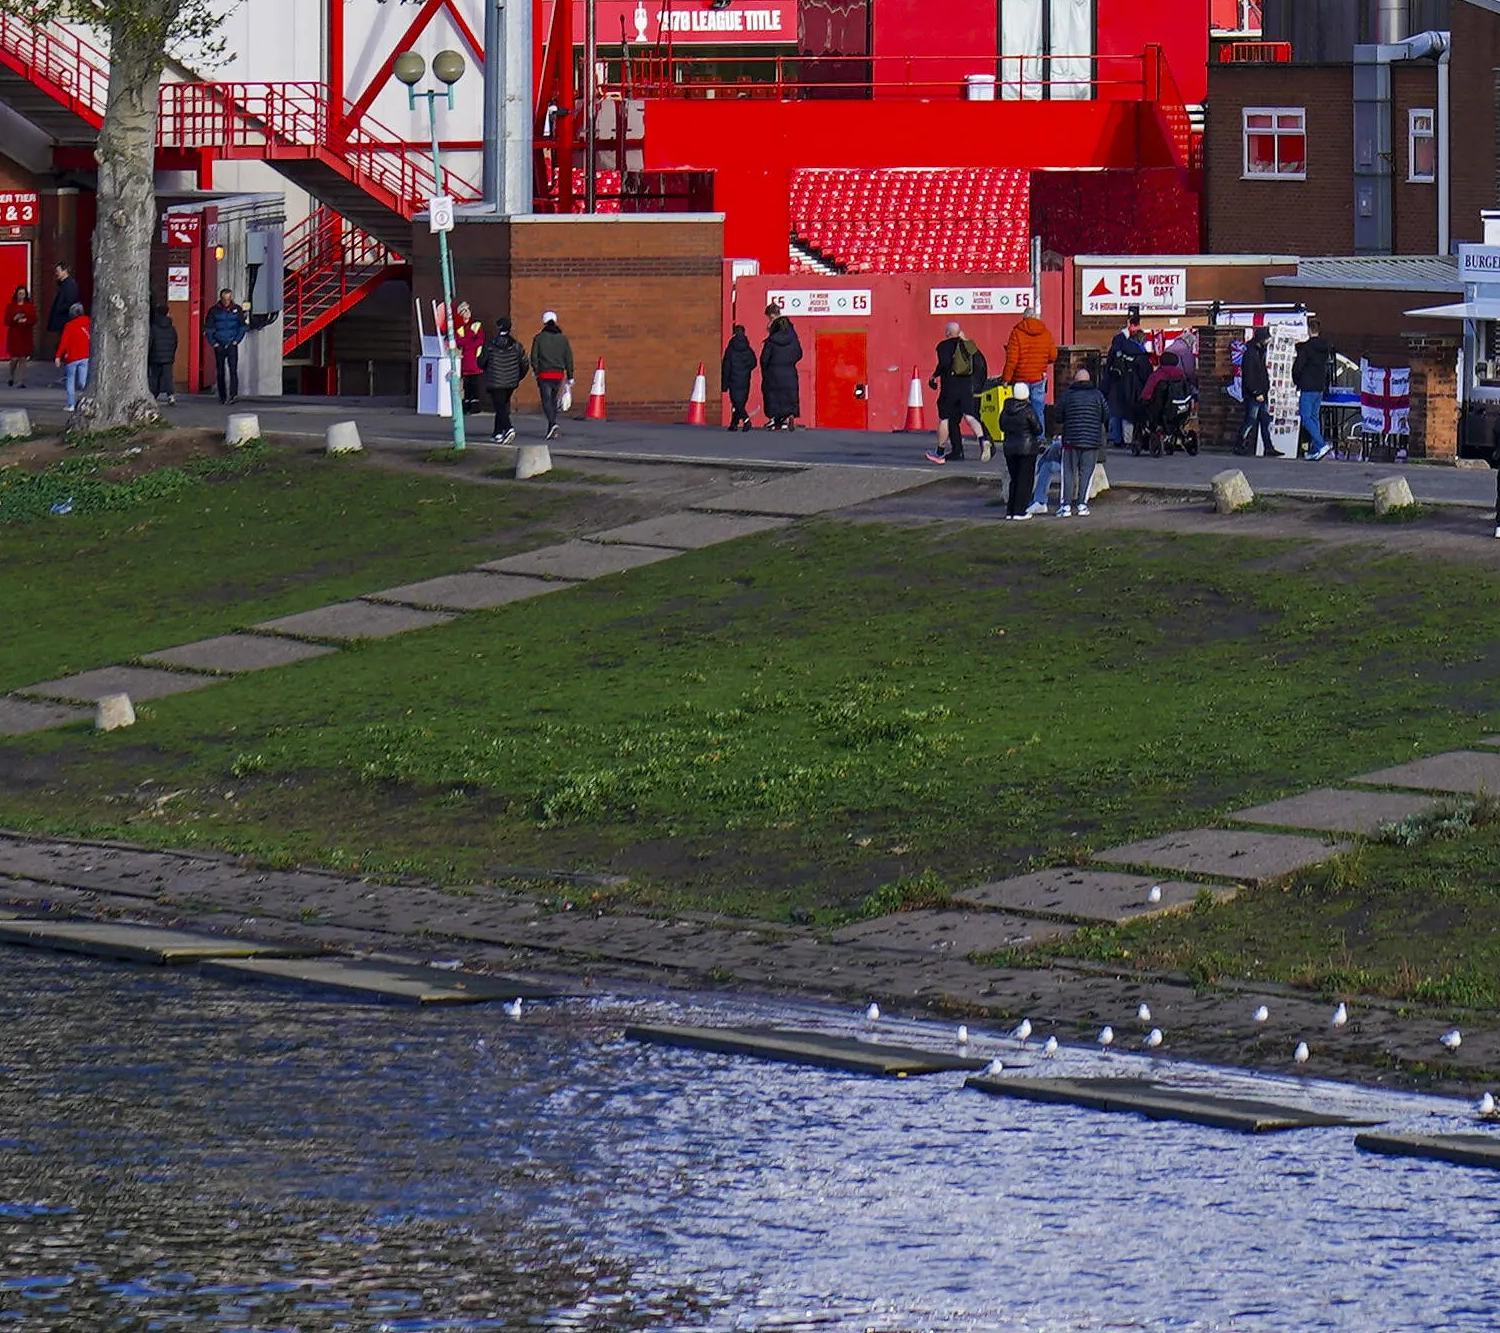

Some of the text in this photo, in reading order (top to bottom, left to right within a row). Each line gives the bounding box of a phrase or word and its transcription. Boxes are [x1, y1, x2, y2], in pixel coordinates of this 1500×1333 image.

[691, 10, 746, 32] LEAGUE
[745, 9, 782, 31] TITLE
[14, 193, 37, 203] TIER
[5, 205, 18, 221] &
[22, 205, 33, 221] 3
[1119, 274, 1181, 297] E5 WICKET
[853, 295, 867, 310] E5
[934, 294, 948, 308] E5
[1015, 293, 1030, 307] E5
[1089, 302, 1099, 311] 24
[1100, 302, 1117, 311] HOUR
